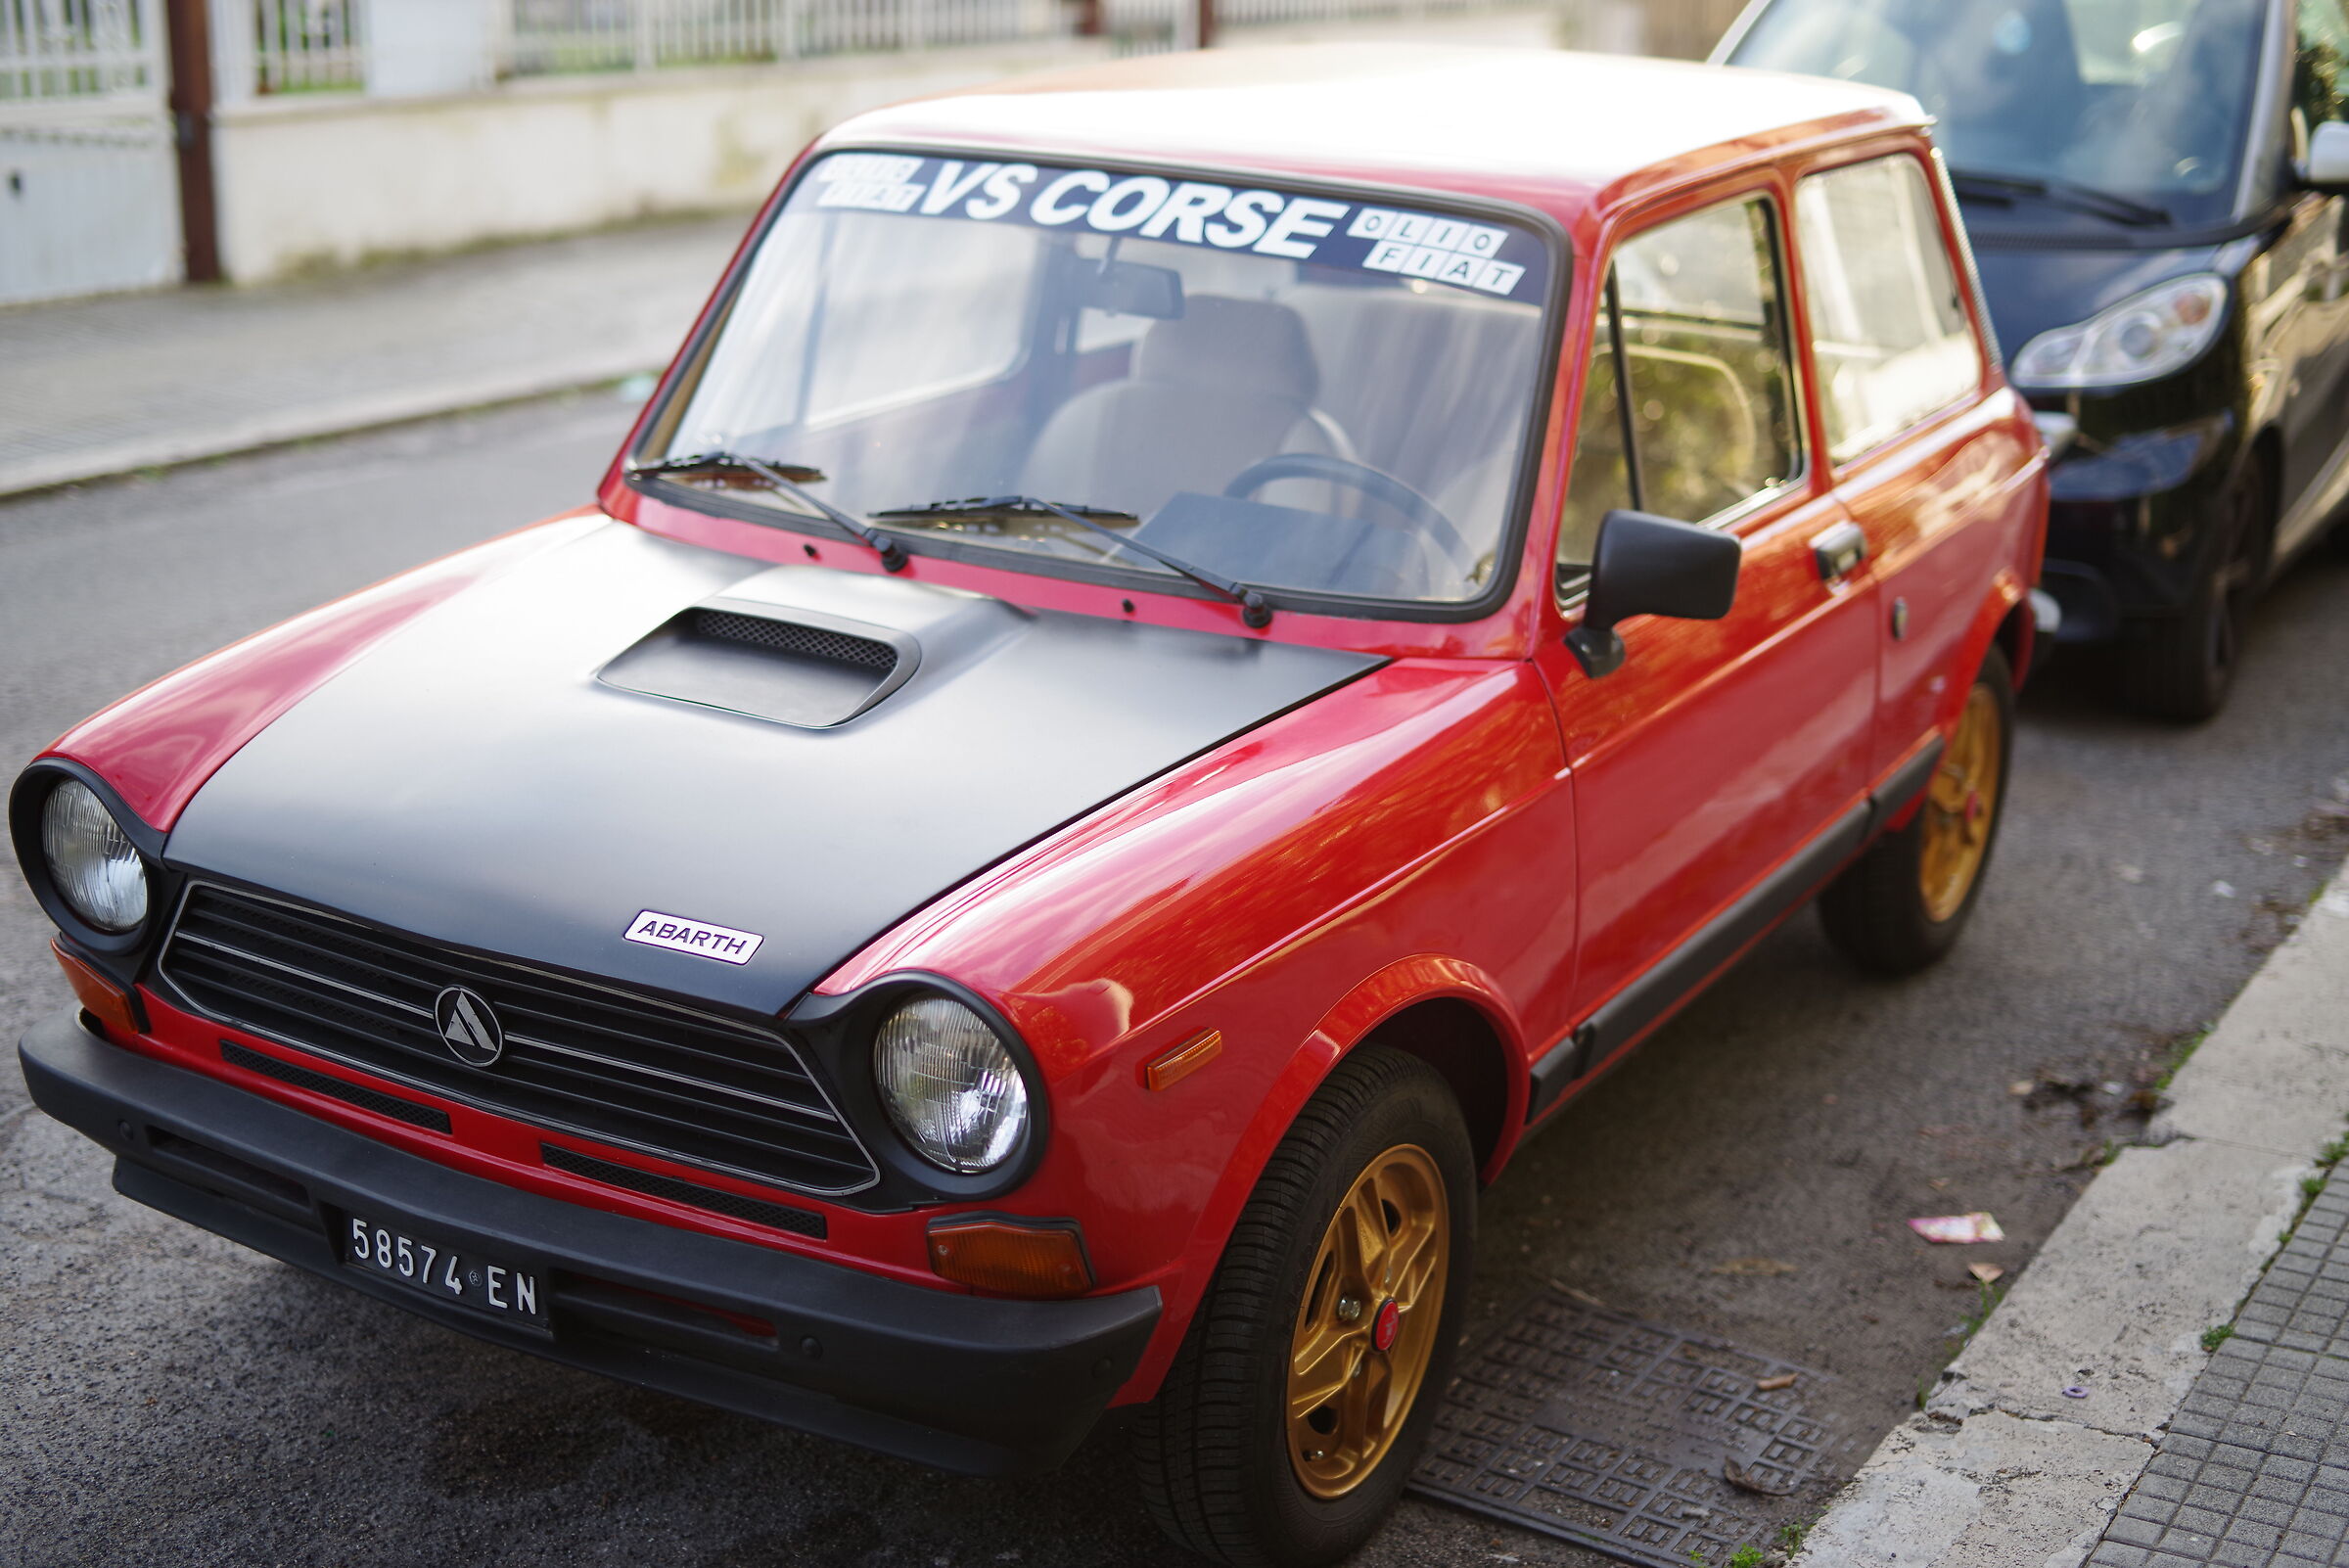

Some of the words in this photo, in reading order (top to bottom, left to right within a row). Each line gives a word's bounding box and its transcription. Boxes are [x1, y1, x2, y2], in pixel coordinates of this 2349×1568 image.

[919, 161, 1038, 220] VS
[1029, 169, 1352, 259] CORSE
[1361, 212, 1495, 252] OLIO
[1376, 245, 1515, 288] FIAT
[637, 920, 748, 955] ABARTH
[352, 1218, 463, 1295] 58574
[487, 1265, 537, 1315] EN
